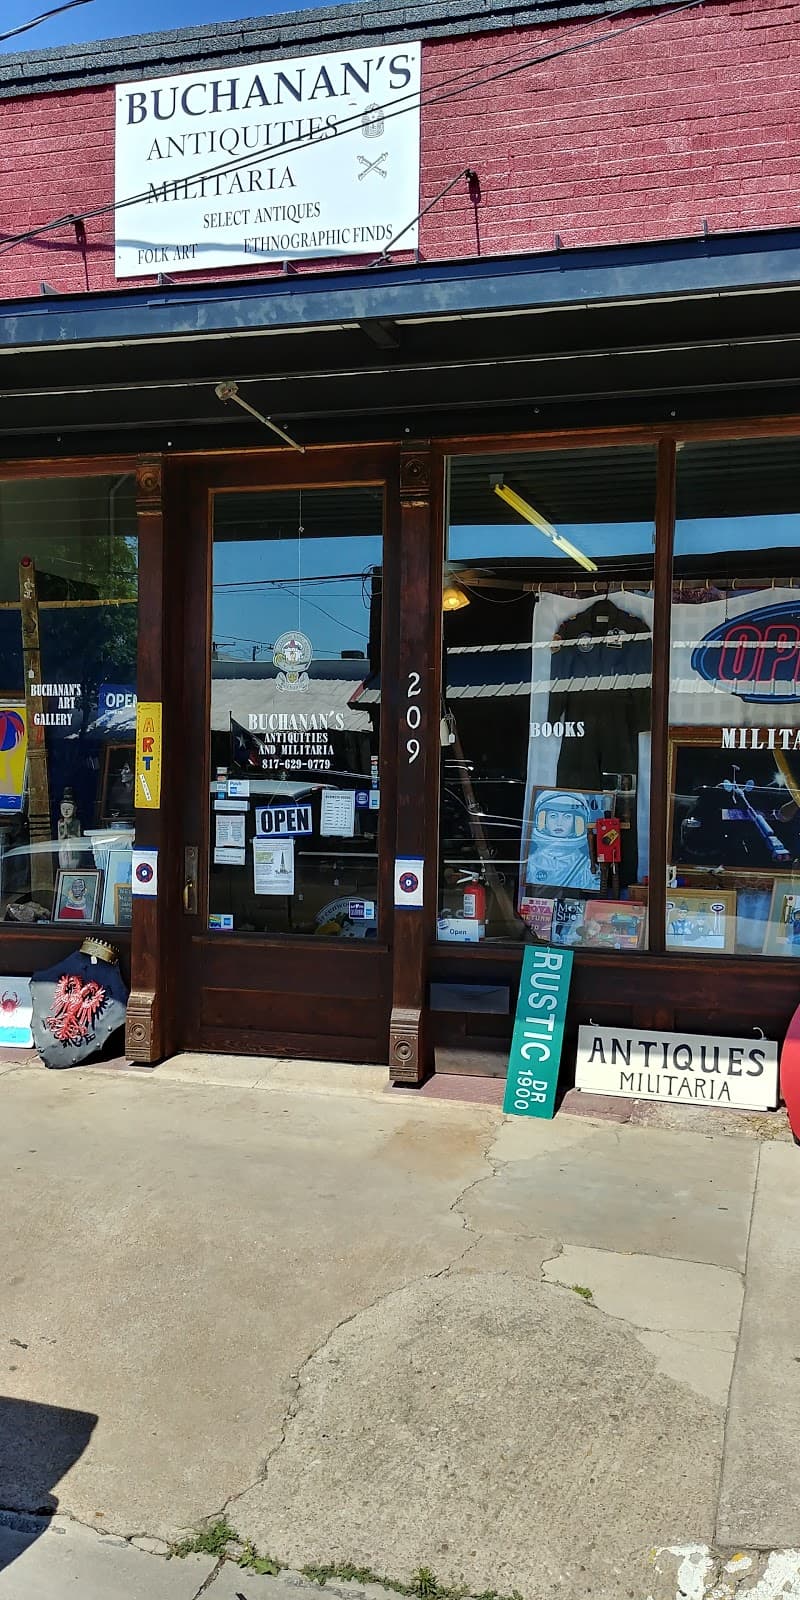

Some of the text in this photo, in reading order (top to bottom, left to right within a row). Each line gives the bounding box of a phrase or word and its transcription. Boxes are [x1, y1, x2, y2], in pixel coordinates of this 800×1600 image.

[126, 54, 412, 125] BUCHANAN'S
[147, 114, 337, 160] ANTIQUITIES
[146, 166, 296, 204] MILITARIA
[203, 202, 321, 229] SELECT ANTIQUES
[244, 224, 393, 253] ETHNOGRAPHIC FINDS
[138, 244, 198, 265] FOLK ART
[31, 684, 81, 697] BUCHANAN'S
[58, 697, 76, 709] ART
[34, 713, 73, 726] GALLERY
[248, 711, 344, 731] BUCHANAN'S
[529, 721, 585, 738] BOOKS
[142, 717, 154, 770] ART
[258, 744, 334, 755] AND MILITARIA
[264, 732, 328, 744] ANTIQUITIES
[262, 759, 331, 769] 817-629-0779
[260, 808, 309, 833] OPEN
[520, 951, 563, 1103] RUSTIC DR
[587, 1037, 766, 1077] ANTIQUES
[514, 1069, 533, 1110] 1900
[620, 1072, 731, 1101] MILITARIA
